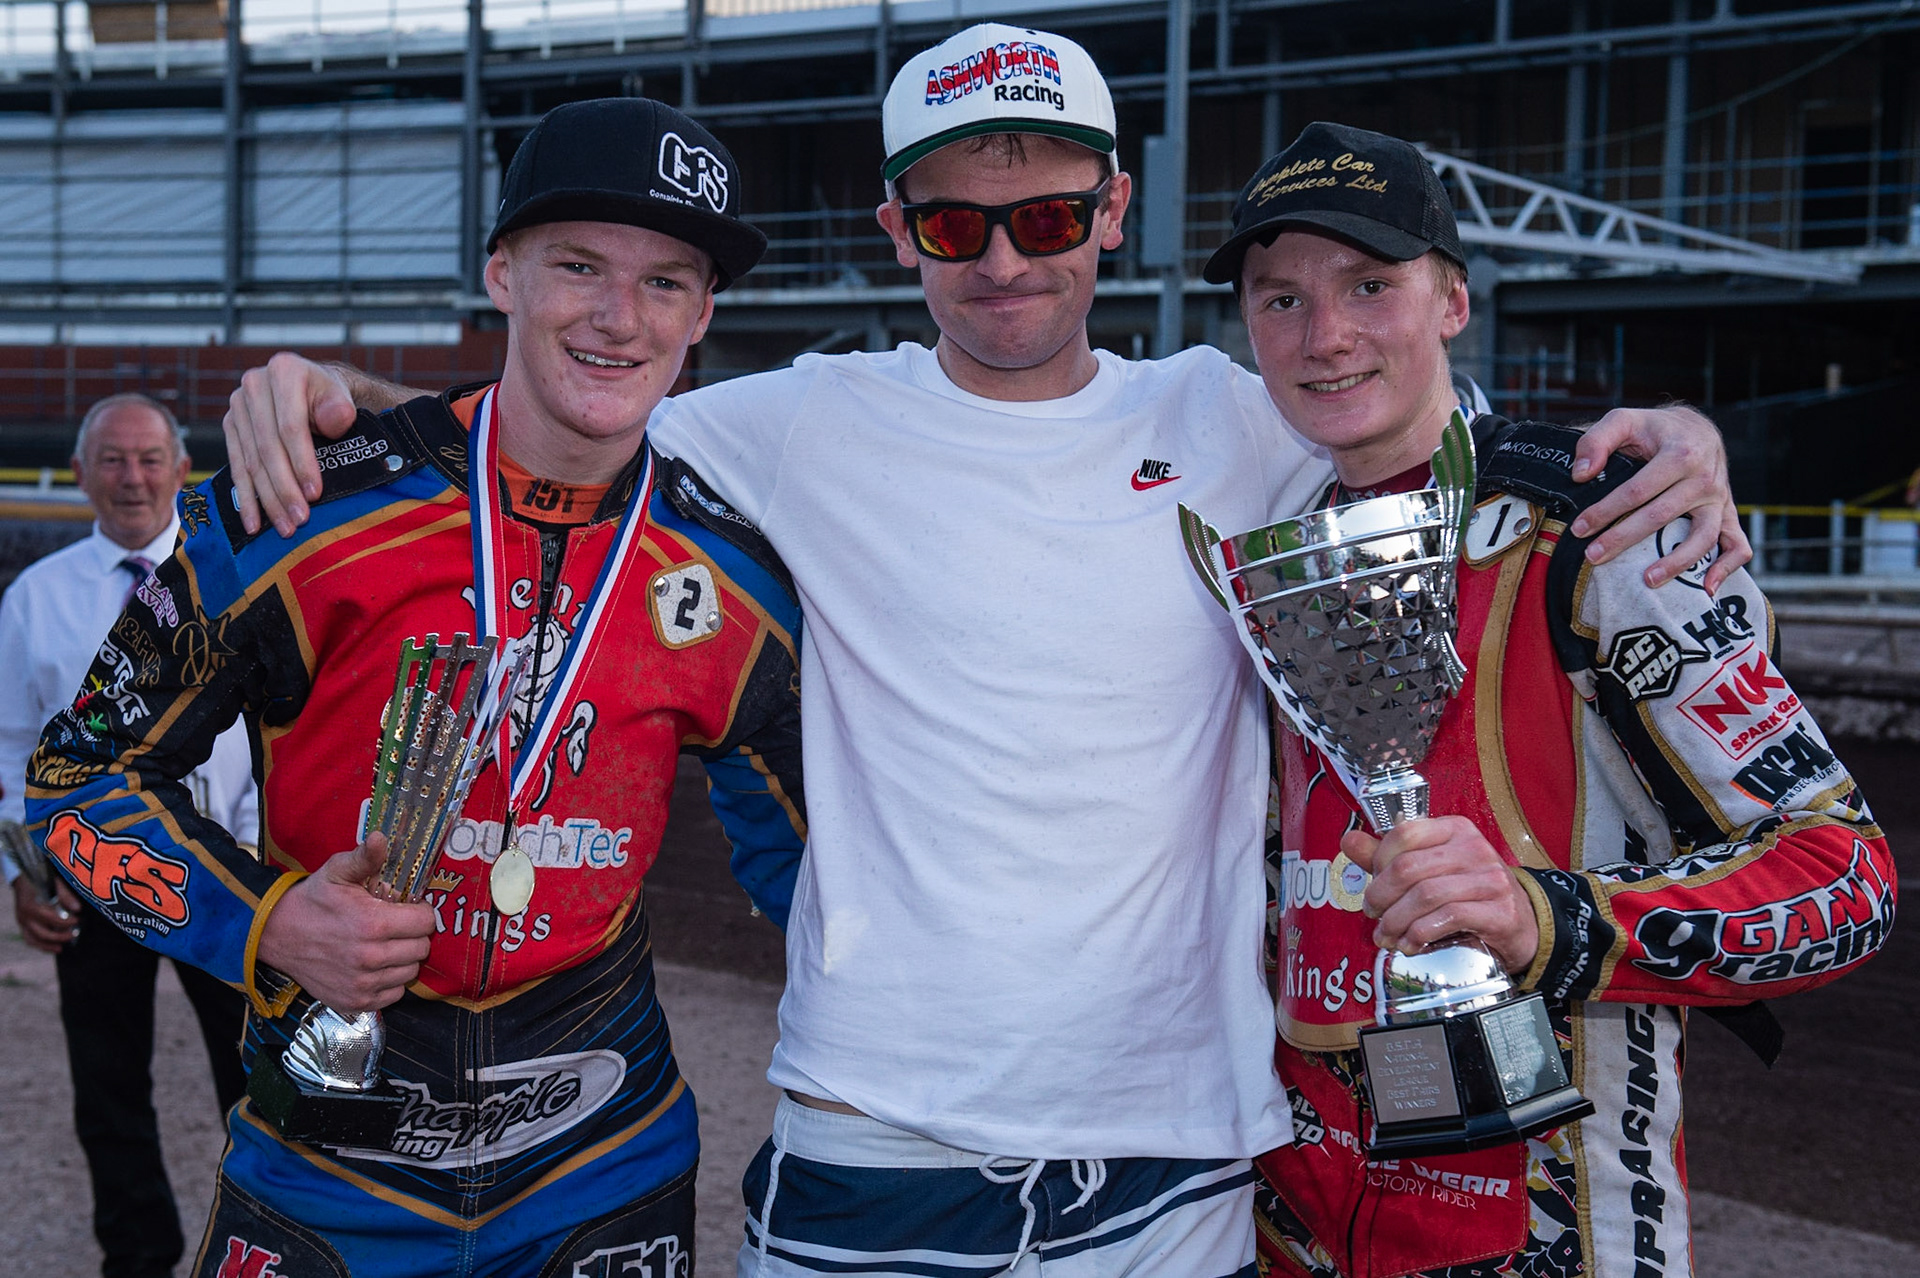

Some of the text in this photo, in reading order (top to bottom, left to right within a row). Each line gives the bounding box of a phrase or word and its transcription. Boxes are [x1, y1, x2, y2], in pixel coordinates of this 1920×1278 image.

[925, 42, 1062, 105] ASHWORTH
[994, 79, 1065, 111] Racing
[1331, 152, 1376, 173] Car
[1257, 173, 1389, 207] Services Ltd
[330, 438, 368, 455] DRIVE
[337, 439, 389, 467] TRUCKS
[1138, 458, 1172, 479] NIKE
[1486, 504, 1510, 548] 1
[674, 577, 702, 631] 2
[1620, 636, 1657, 672] JC
[1626, 644, 1683, 700] PRO
[1730, 711, 1784, 752] SPARK
[46, 814, 188, 924] CFS
[114, 911, 170, 935] Filtration
[424, 892, 552, 952] Kings
[1285, 952, 1374, 1013] Kings
[1553, 951, 1590, 999] WEAR
[400, 1071, 583, 1147] happle
[393, 1134, 447, 1157] ing
[1291, 1116, 1326, 1145] RO
[1366, 1175, 1478, 1211] CTORY RIDER
[1410, 1160, 1512, 1199] WEAR
